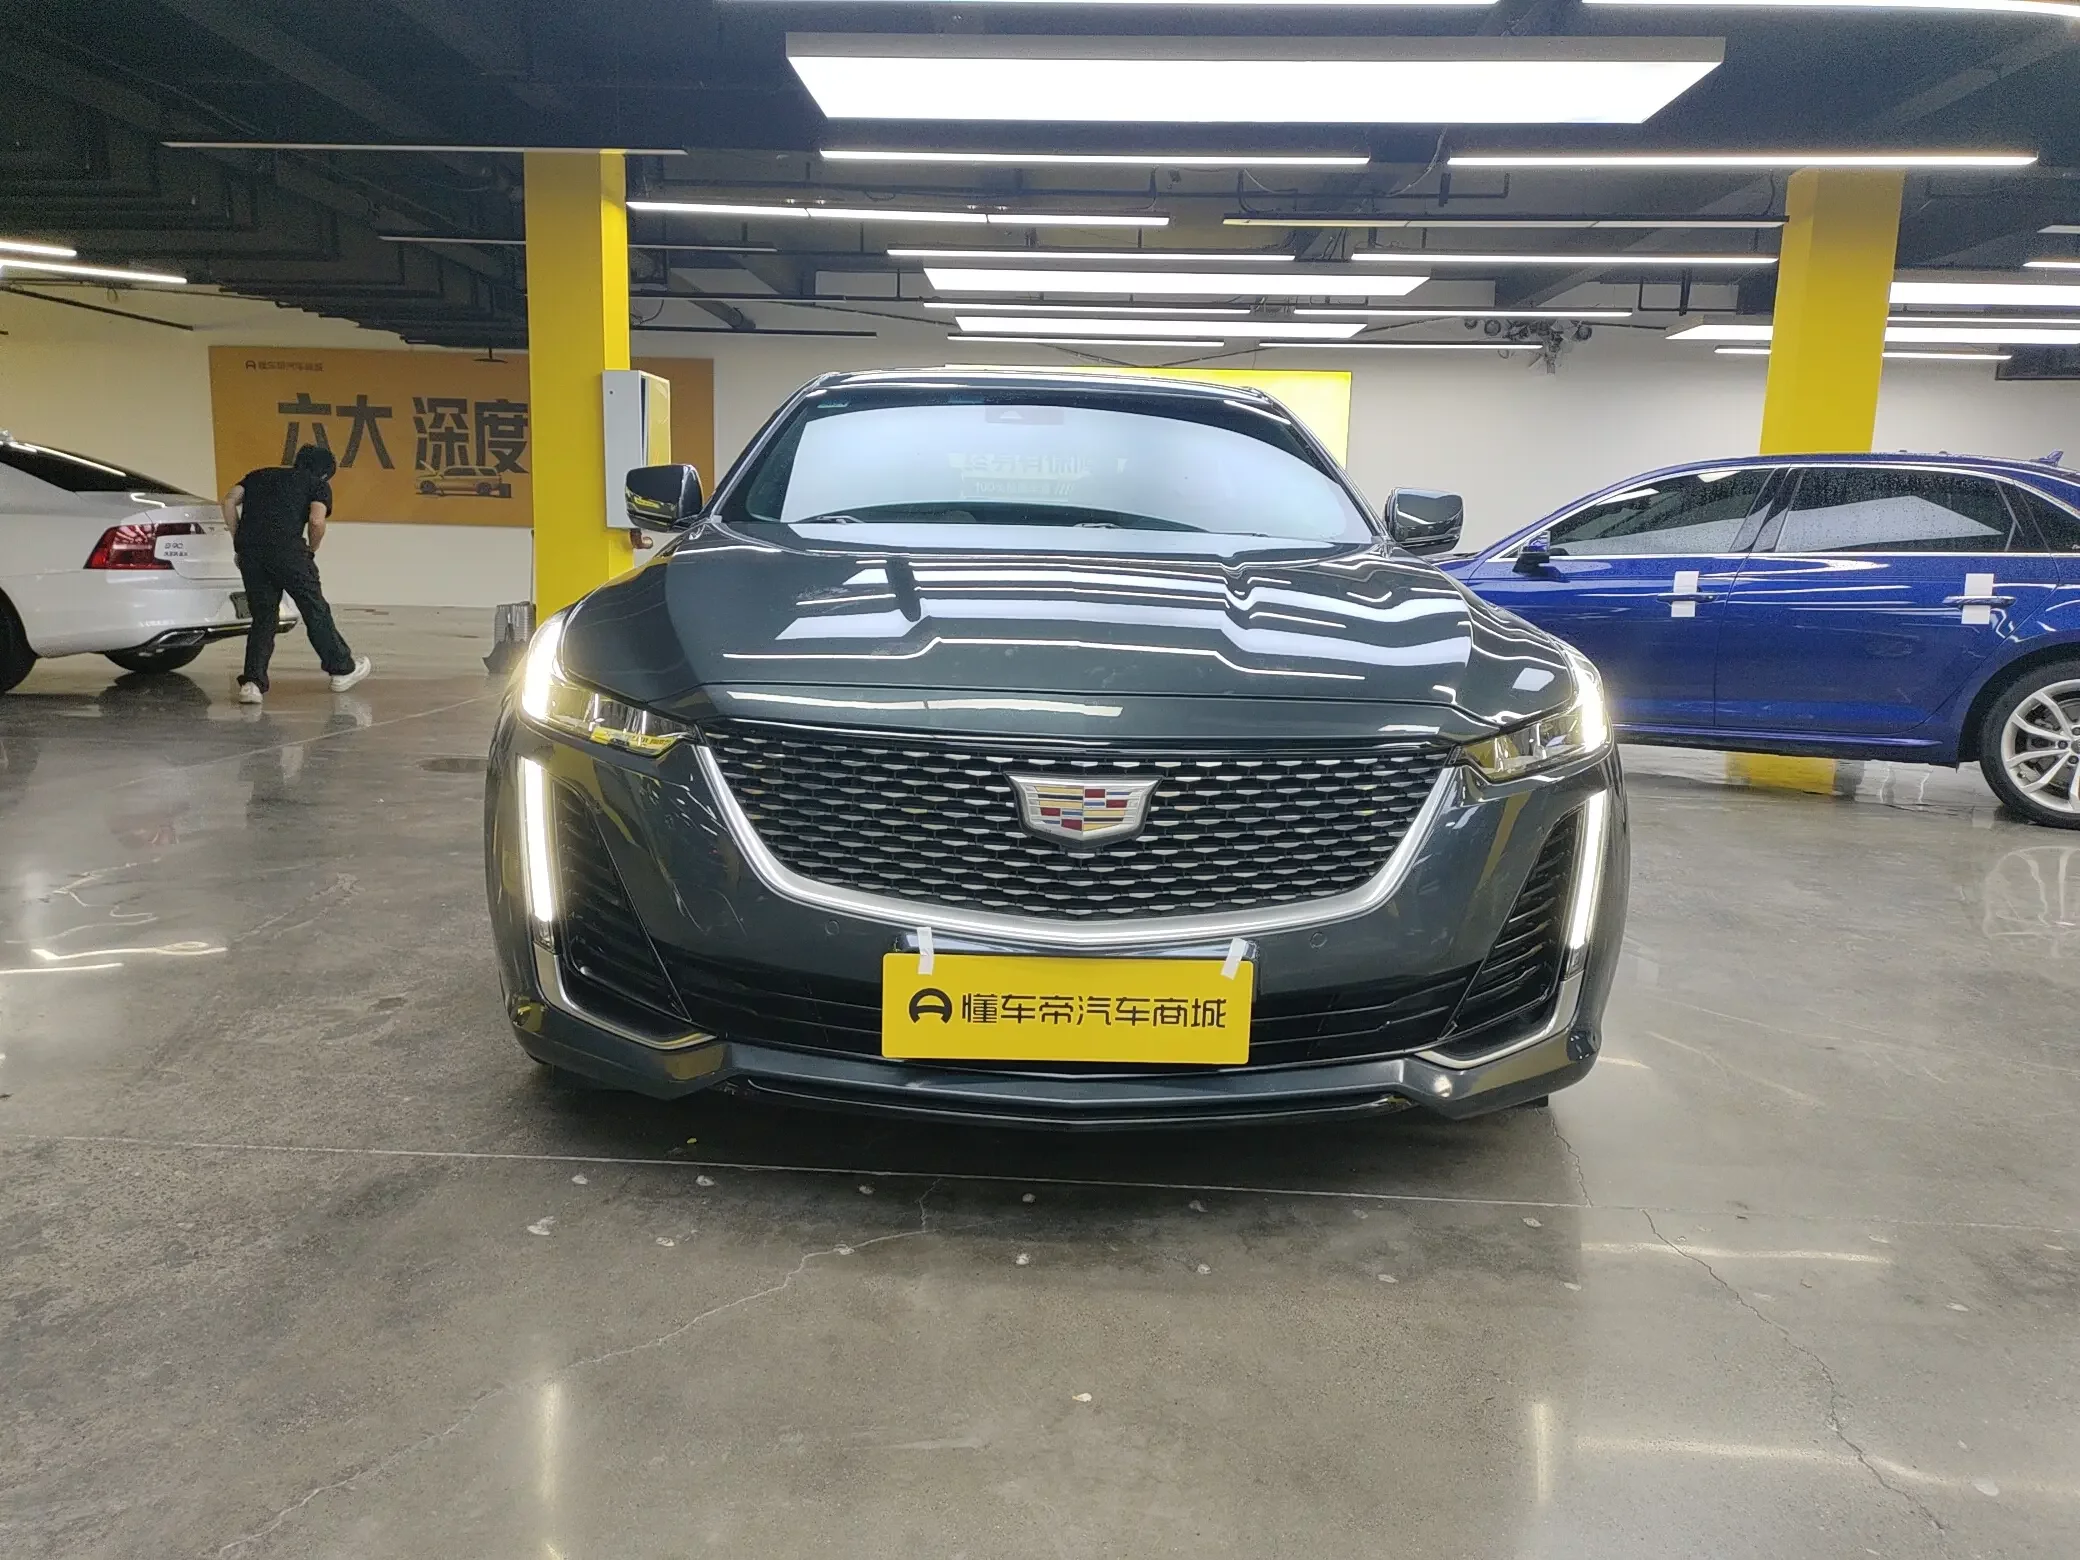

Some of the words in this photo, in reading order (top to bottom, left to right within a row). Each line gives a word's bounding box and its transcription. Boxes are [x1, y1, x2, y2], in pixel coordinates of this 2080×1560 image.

[961, 992, 1227, 1029] 懂车帝汽车商城
